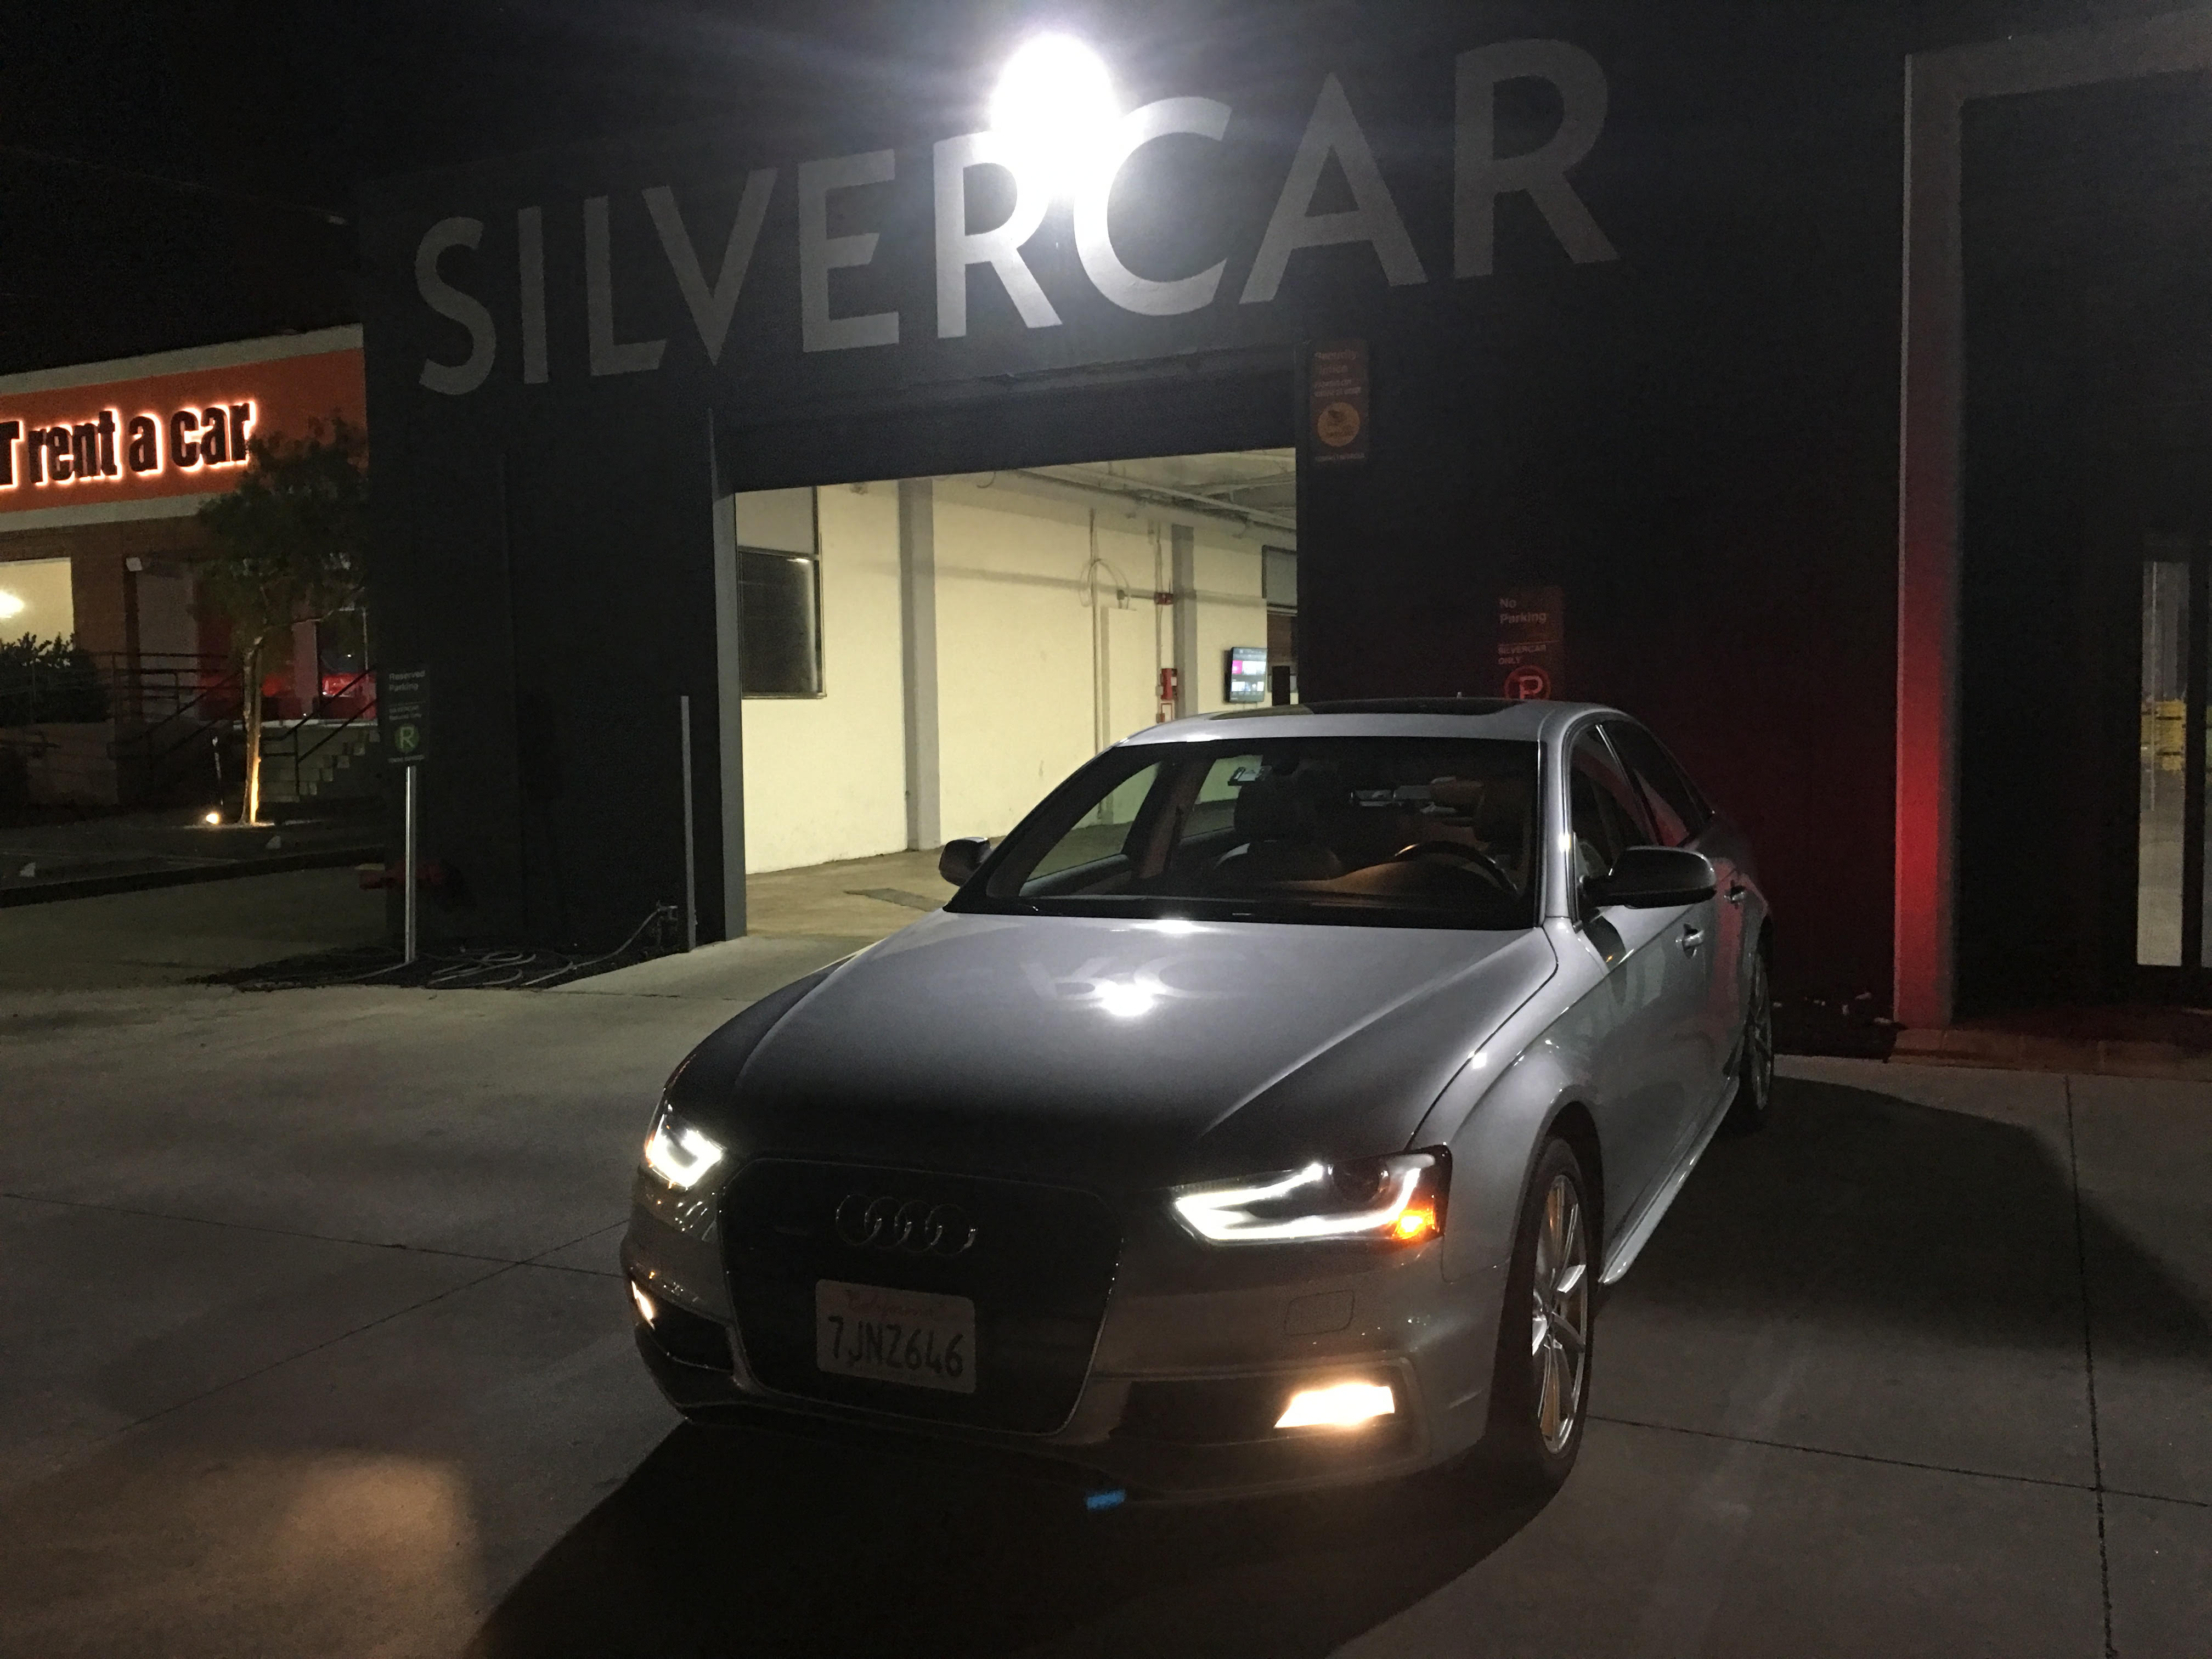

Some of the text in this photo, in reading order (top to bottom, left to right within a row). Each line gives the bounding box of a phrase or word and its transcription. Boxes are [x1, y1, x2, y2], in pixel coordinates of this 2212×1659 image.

[415, 36, 1621, 396] SILVERCAR
[27, 408, 121, 485] rent
[128, 415, 159, 473] a
[170, 402, 253, 470] car
[1499, 599, 1517, 609] No
[1499, 612, 1547, 624] Parking
[388, 670, 426, 680] Reserved
[388, 682, 419, 692] Parking
[828, 1314, 964, 1378] 7JNZ646
